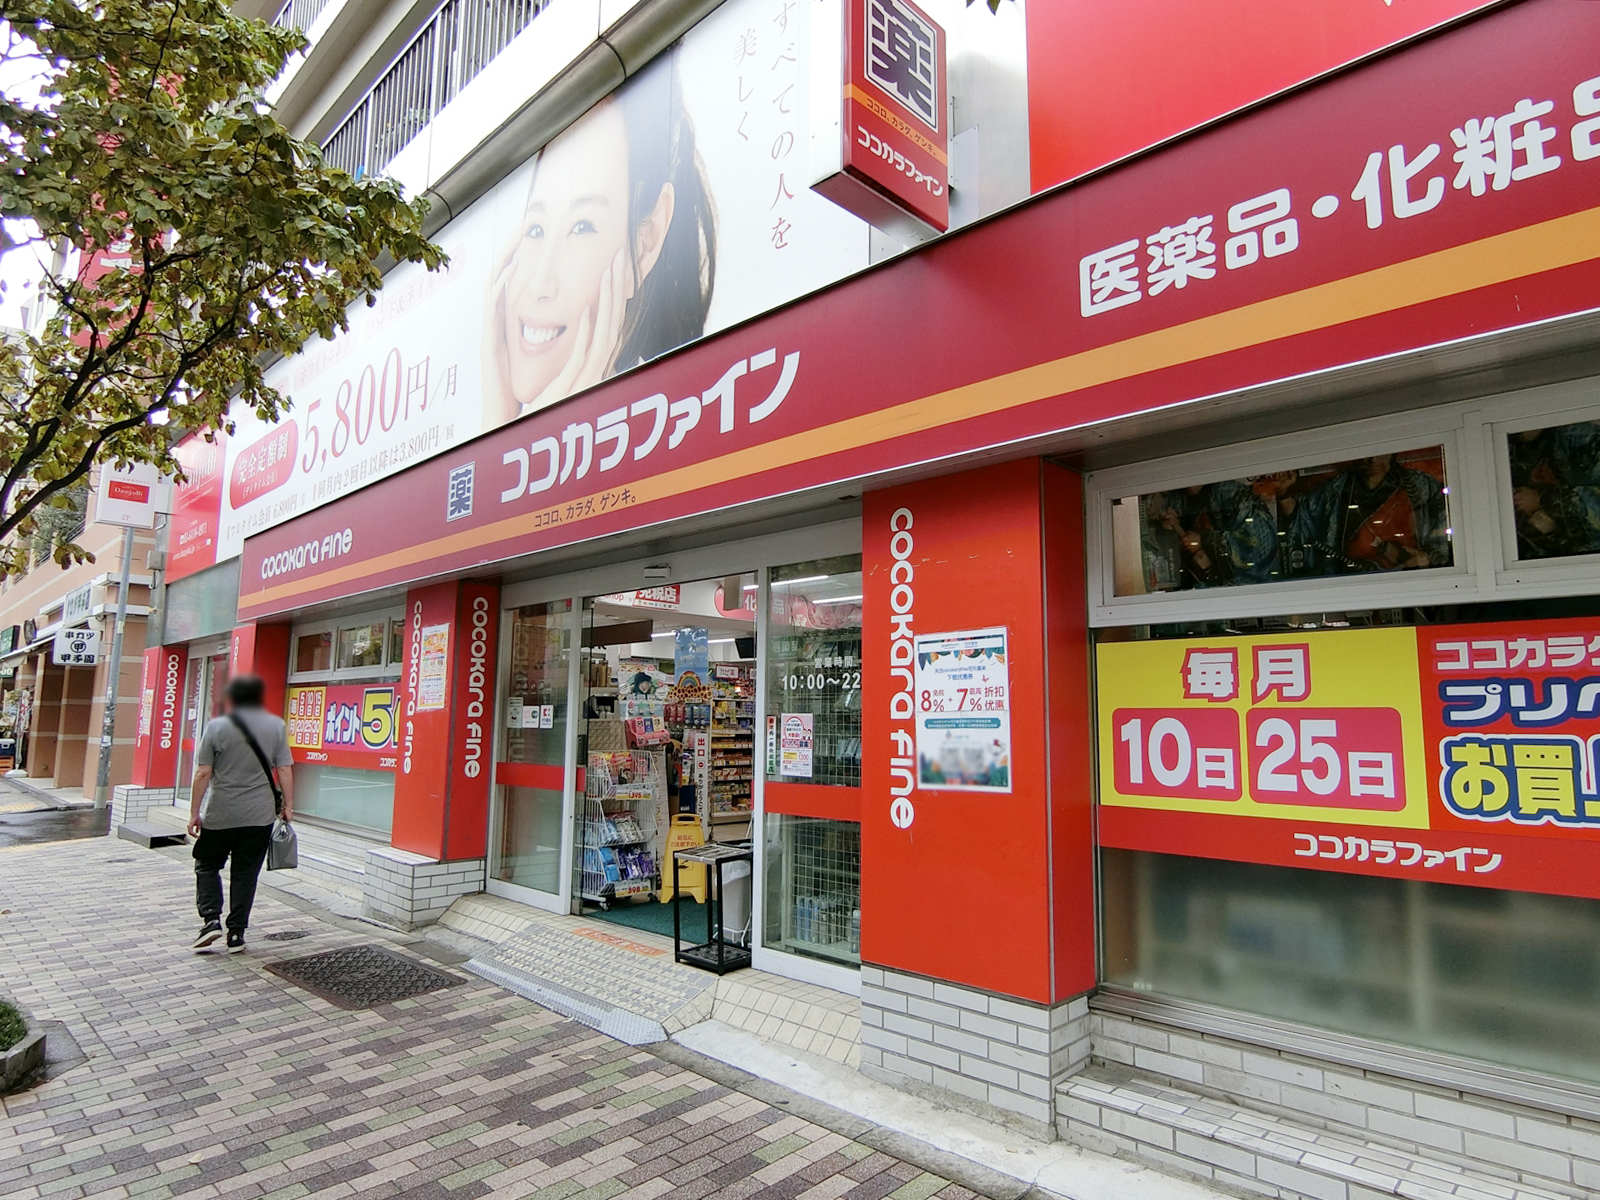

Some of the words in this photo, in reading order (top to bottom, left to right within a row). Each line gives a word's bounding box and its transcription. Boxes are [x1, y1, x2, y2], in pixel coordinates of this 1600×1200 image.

[734, 28, 757, 141] 美しく
[770, 2, 797, 249] すべての人を
[857, 125, 943, 197] ココカラファイン
[501, 348, 800, 503] ココカラファイン
[237, 430, 290, 486] 完全定額制
[449, 464, 475, 518] 薬
[534, 488, 637, 528] ココロ、カラダ、ゲンキ。
[261, 546, 320, 580] cocokara
[64, 631, 95, 640] 串カツ
[890, 507, 914, 720] cocokara
[61, 653, 95, 664] 甲子園
[407, 600, 423, 717] cocokara
[467, 596, 489, 718] cocokara
[814, 655, 853, 669] 営業時間
[1186, 648, 1307, 699] 毎月
[163, 654, 179, 718] cocokara
[984, 686, 1004, 698] 折扣
[984, 700, 1004, 711] 优惠
[697, 738, 705, 757] 出口
[1119, 717, 1235, 790] 10日
[1255, 717, 1396, 798] 25日
[1294, 832, 1502, 873] ココカラファイン
